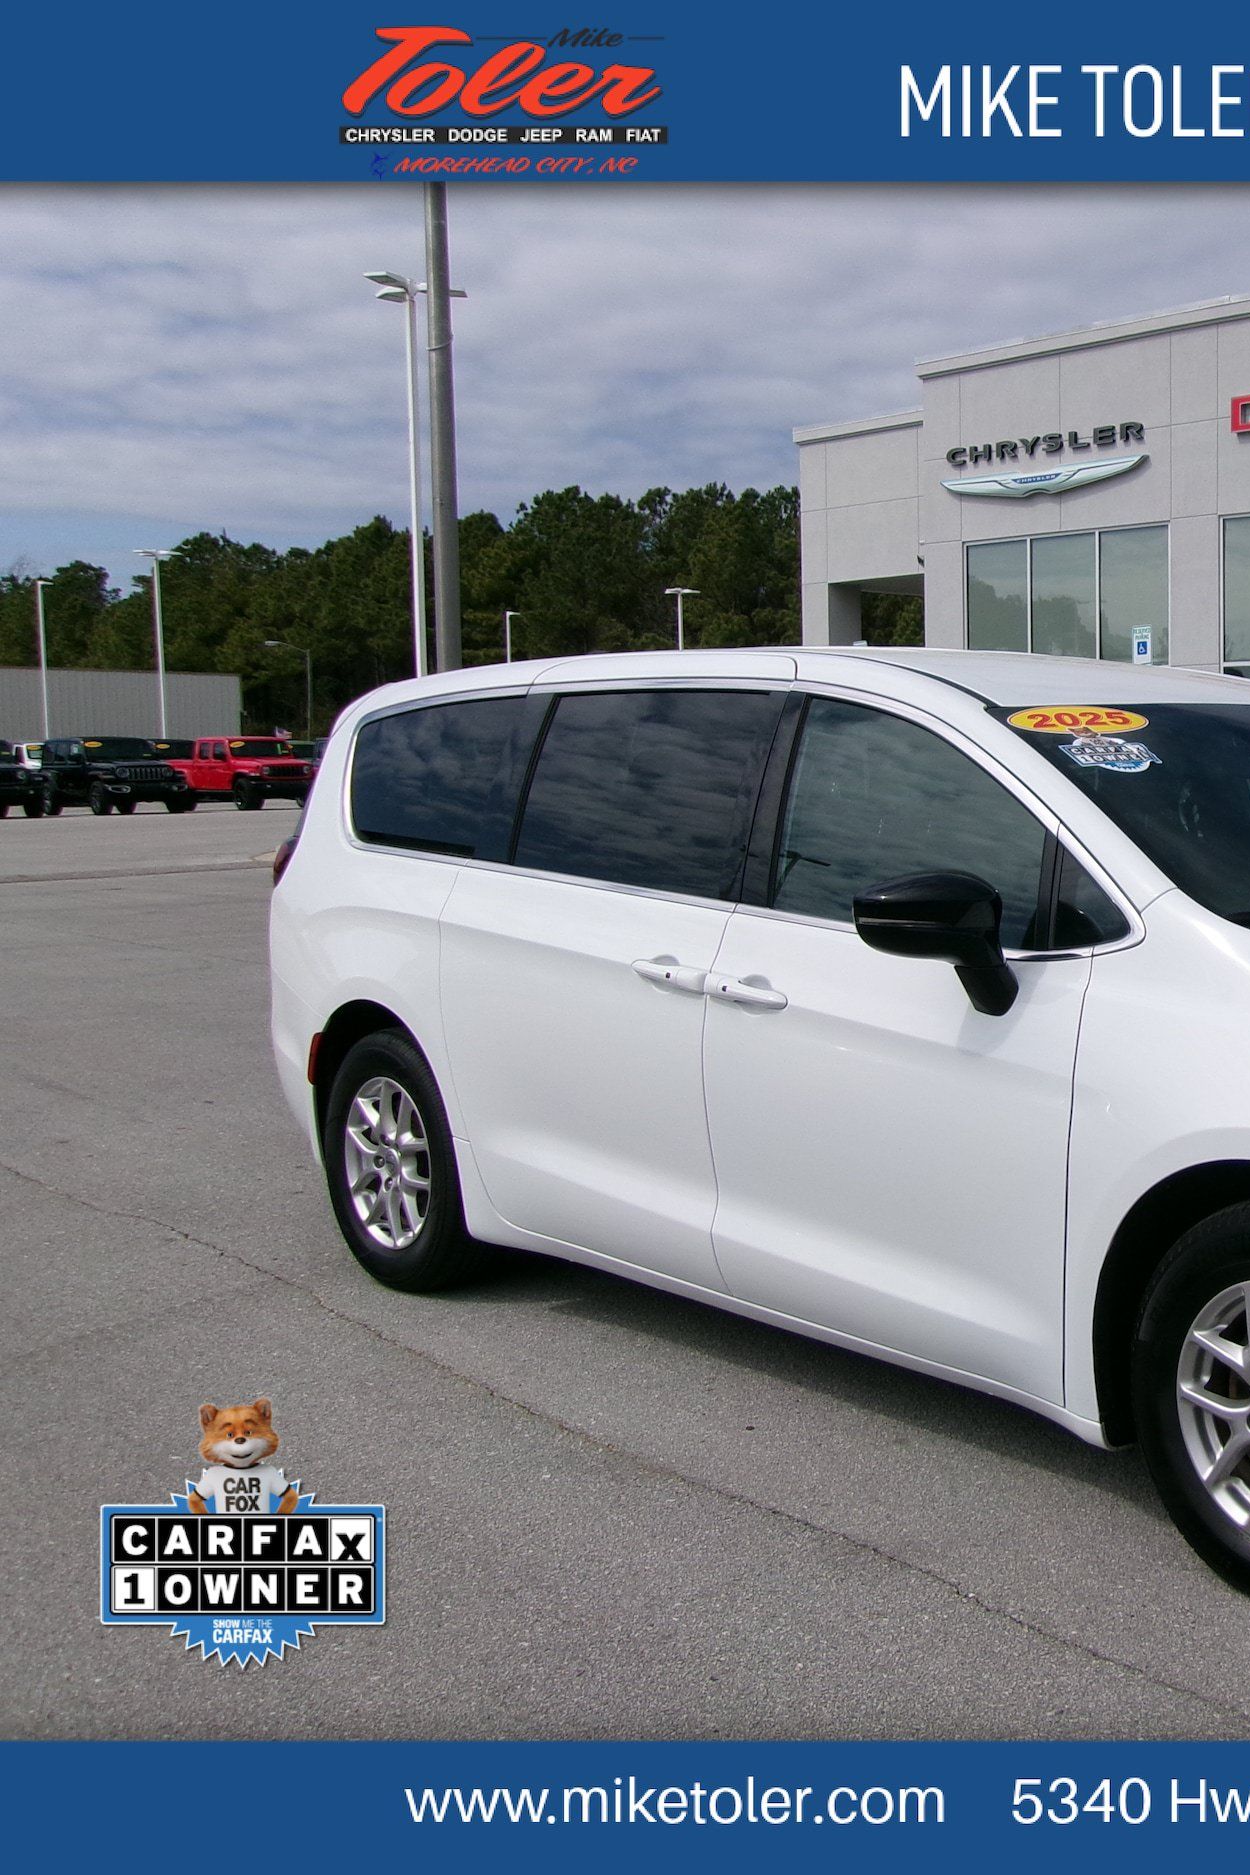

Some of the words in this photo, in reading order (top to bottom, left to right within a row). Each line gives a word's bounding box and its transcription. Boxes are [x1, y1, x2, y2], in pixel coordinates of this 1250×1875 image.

[945, 421, 1146, 466] CHRYSLER
[1027, 711, 1132, 728] 2025
[1070, 744, 1142, 755] CARFA
